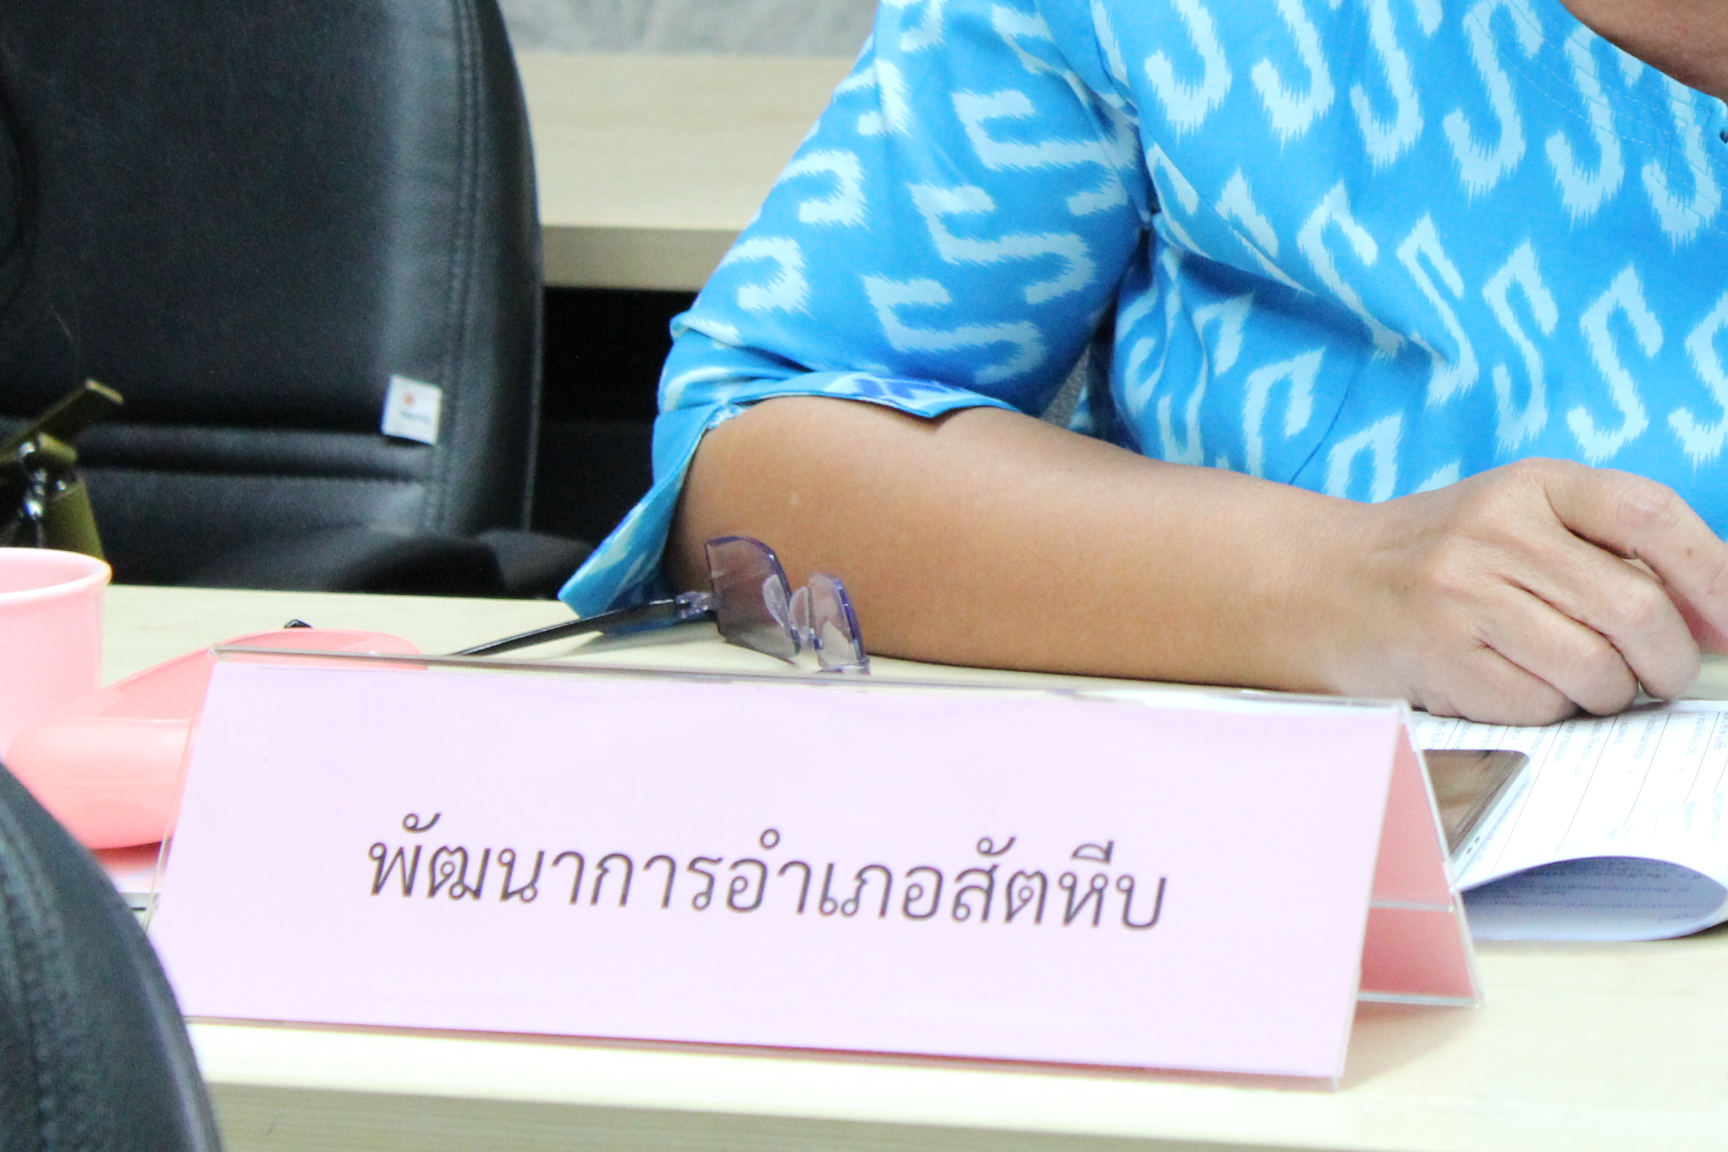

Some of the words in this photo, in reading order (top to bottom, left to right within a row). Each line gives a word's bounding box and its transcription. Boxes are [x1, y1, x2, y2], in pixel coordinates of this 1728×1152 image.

[366, 811, 1168, 931] พัฒนาการอำเภอสัตหีบ
